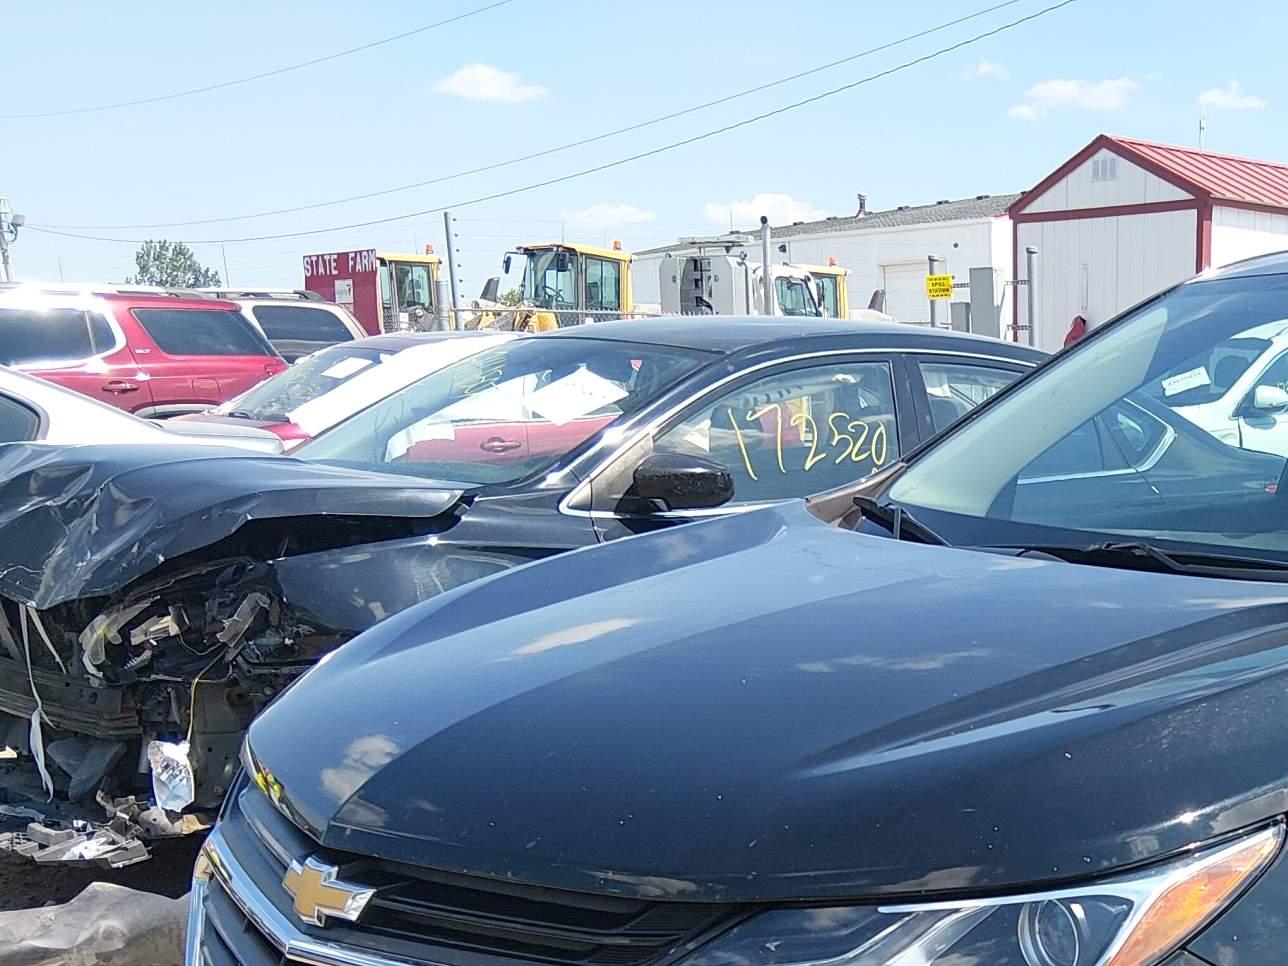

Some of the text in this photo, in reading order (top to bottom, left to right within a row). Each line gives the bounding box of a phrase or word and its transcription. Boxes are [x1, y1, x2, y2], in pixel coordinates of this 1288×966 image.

[304, 249, 376, 277] STATE FARM
[728, 403, 887, 481] 172520
